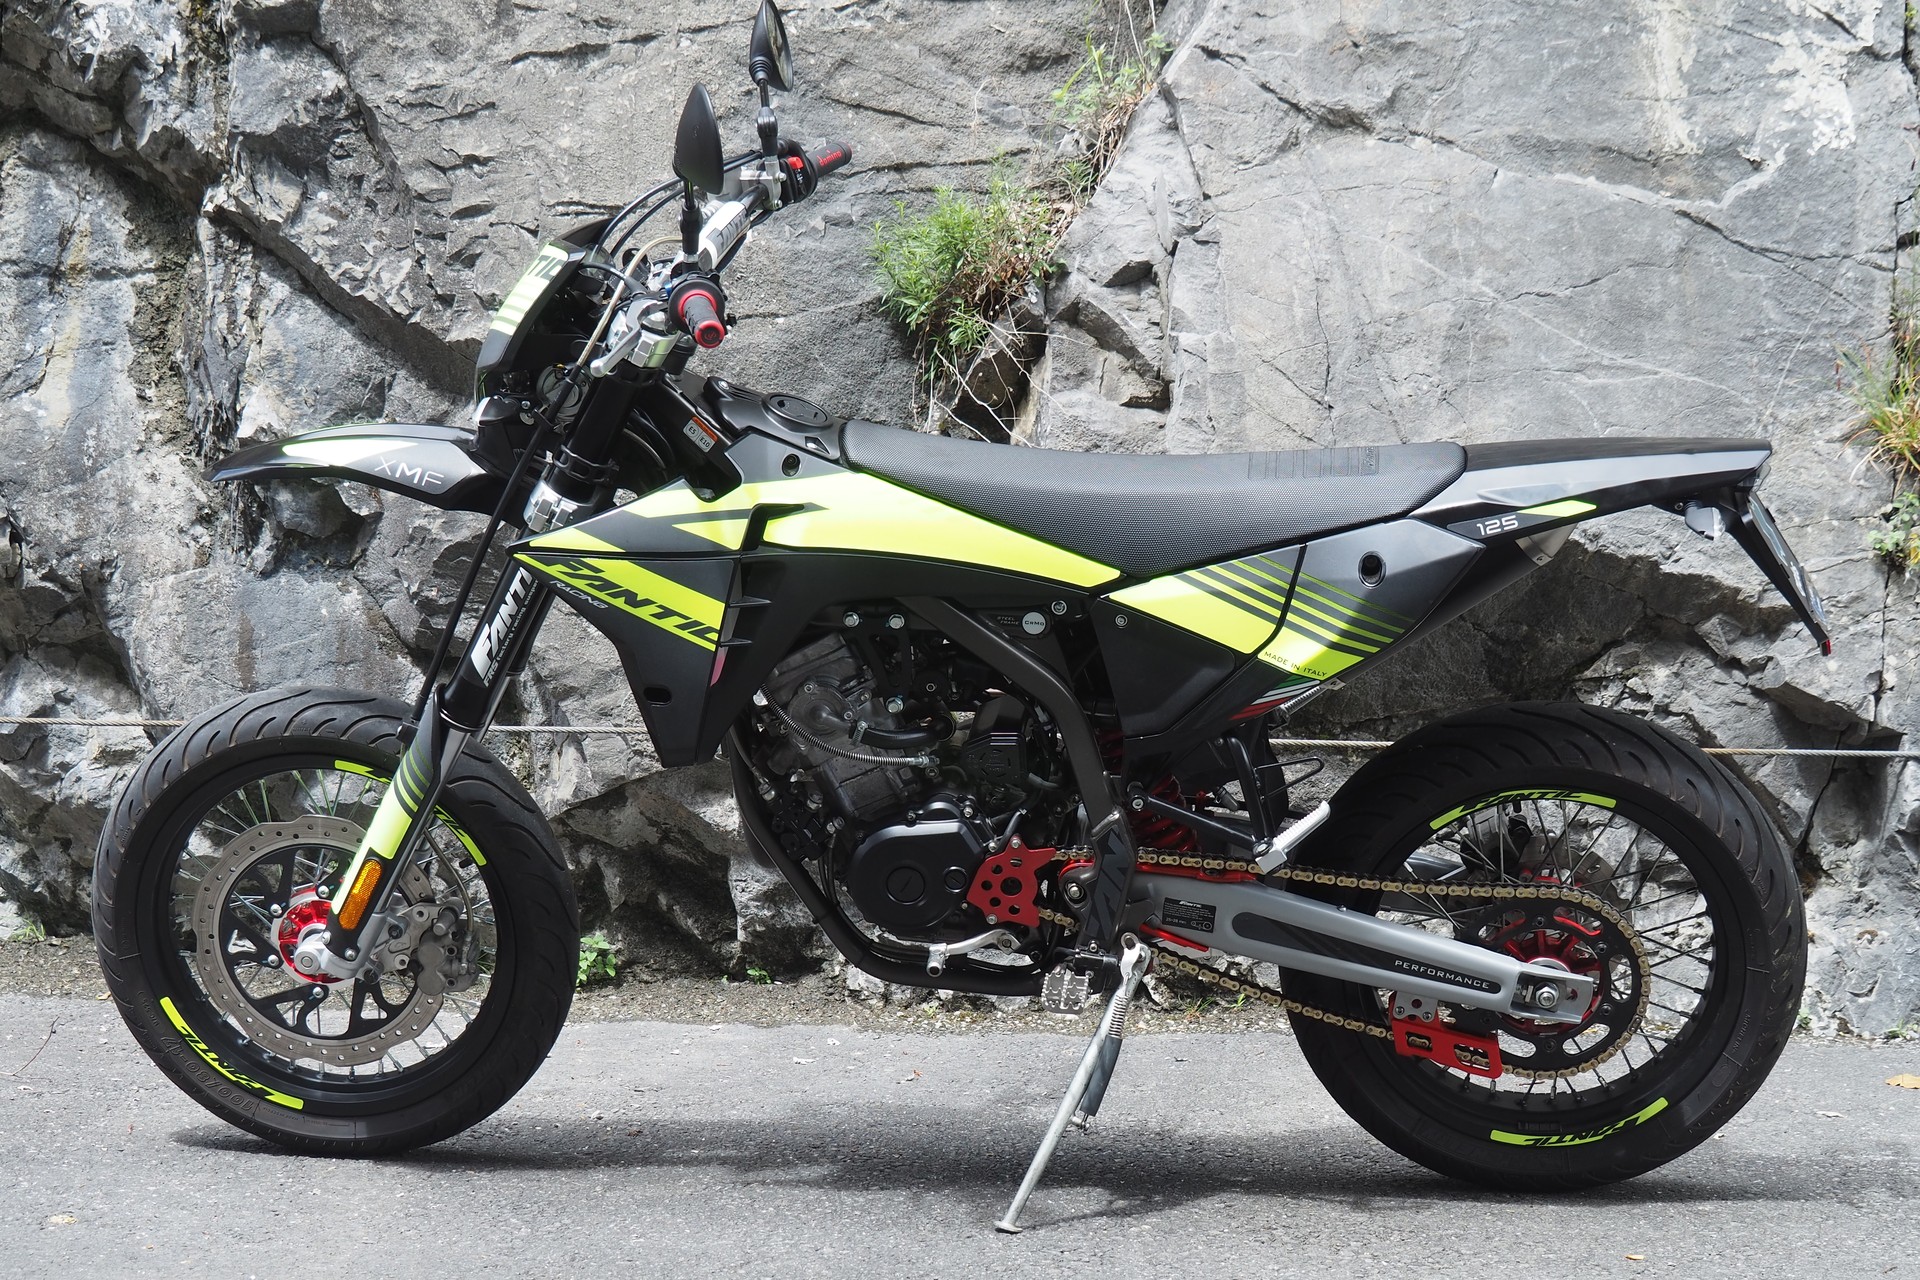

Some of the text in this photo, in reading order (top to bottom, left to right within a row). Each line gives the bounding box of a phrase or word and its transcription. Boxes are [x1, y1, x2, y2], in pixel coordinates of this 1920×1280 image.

[817, 150, 842, 166] domino
[689, 426, 697, 435] E5
[700, 437, 710, 448] E10
[374, 456, 444, 486] XMF
[1476, 515, 1519, 536] 125
[545, 558, 720, 645] FANTIC
[550, 580, 609, 609] RACING
[483, 660, 499, 688] FRS
[498, 632, 514, 661] factory
[512, 607, 527, 632] racing
[1264, 651, 1327, 677] MADE IN ITALY
[1394, 960, 1490, 989] PERFORMANCE
